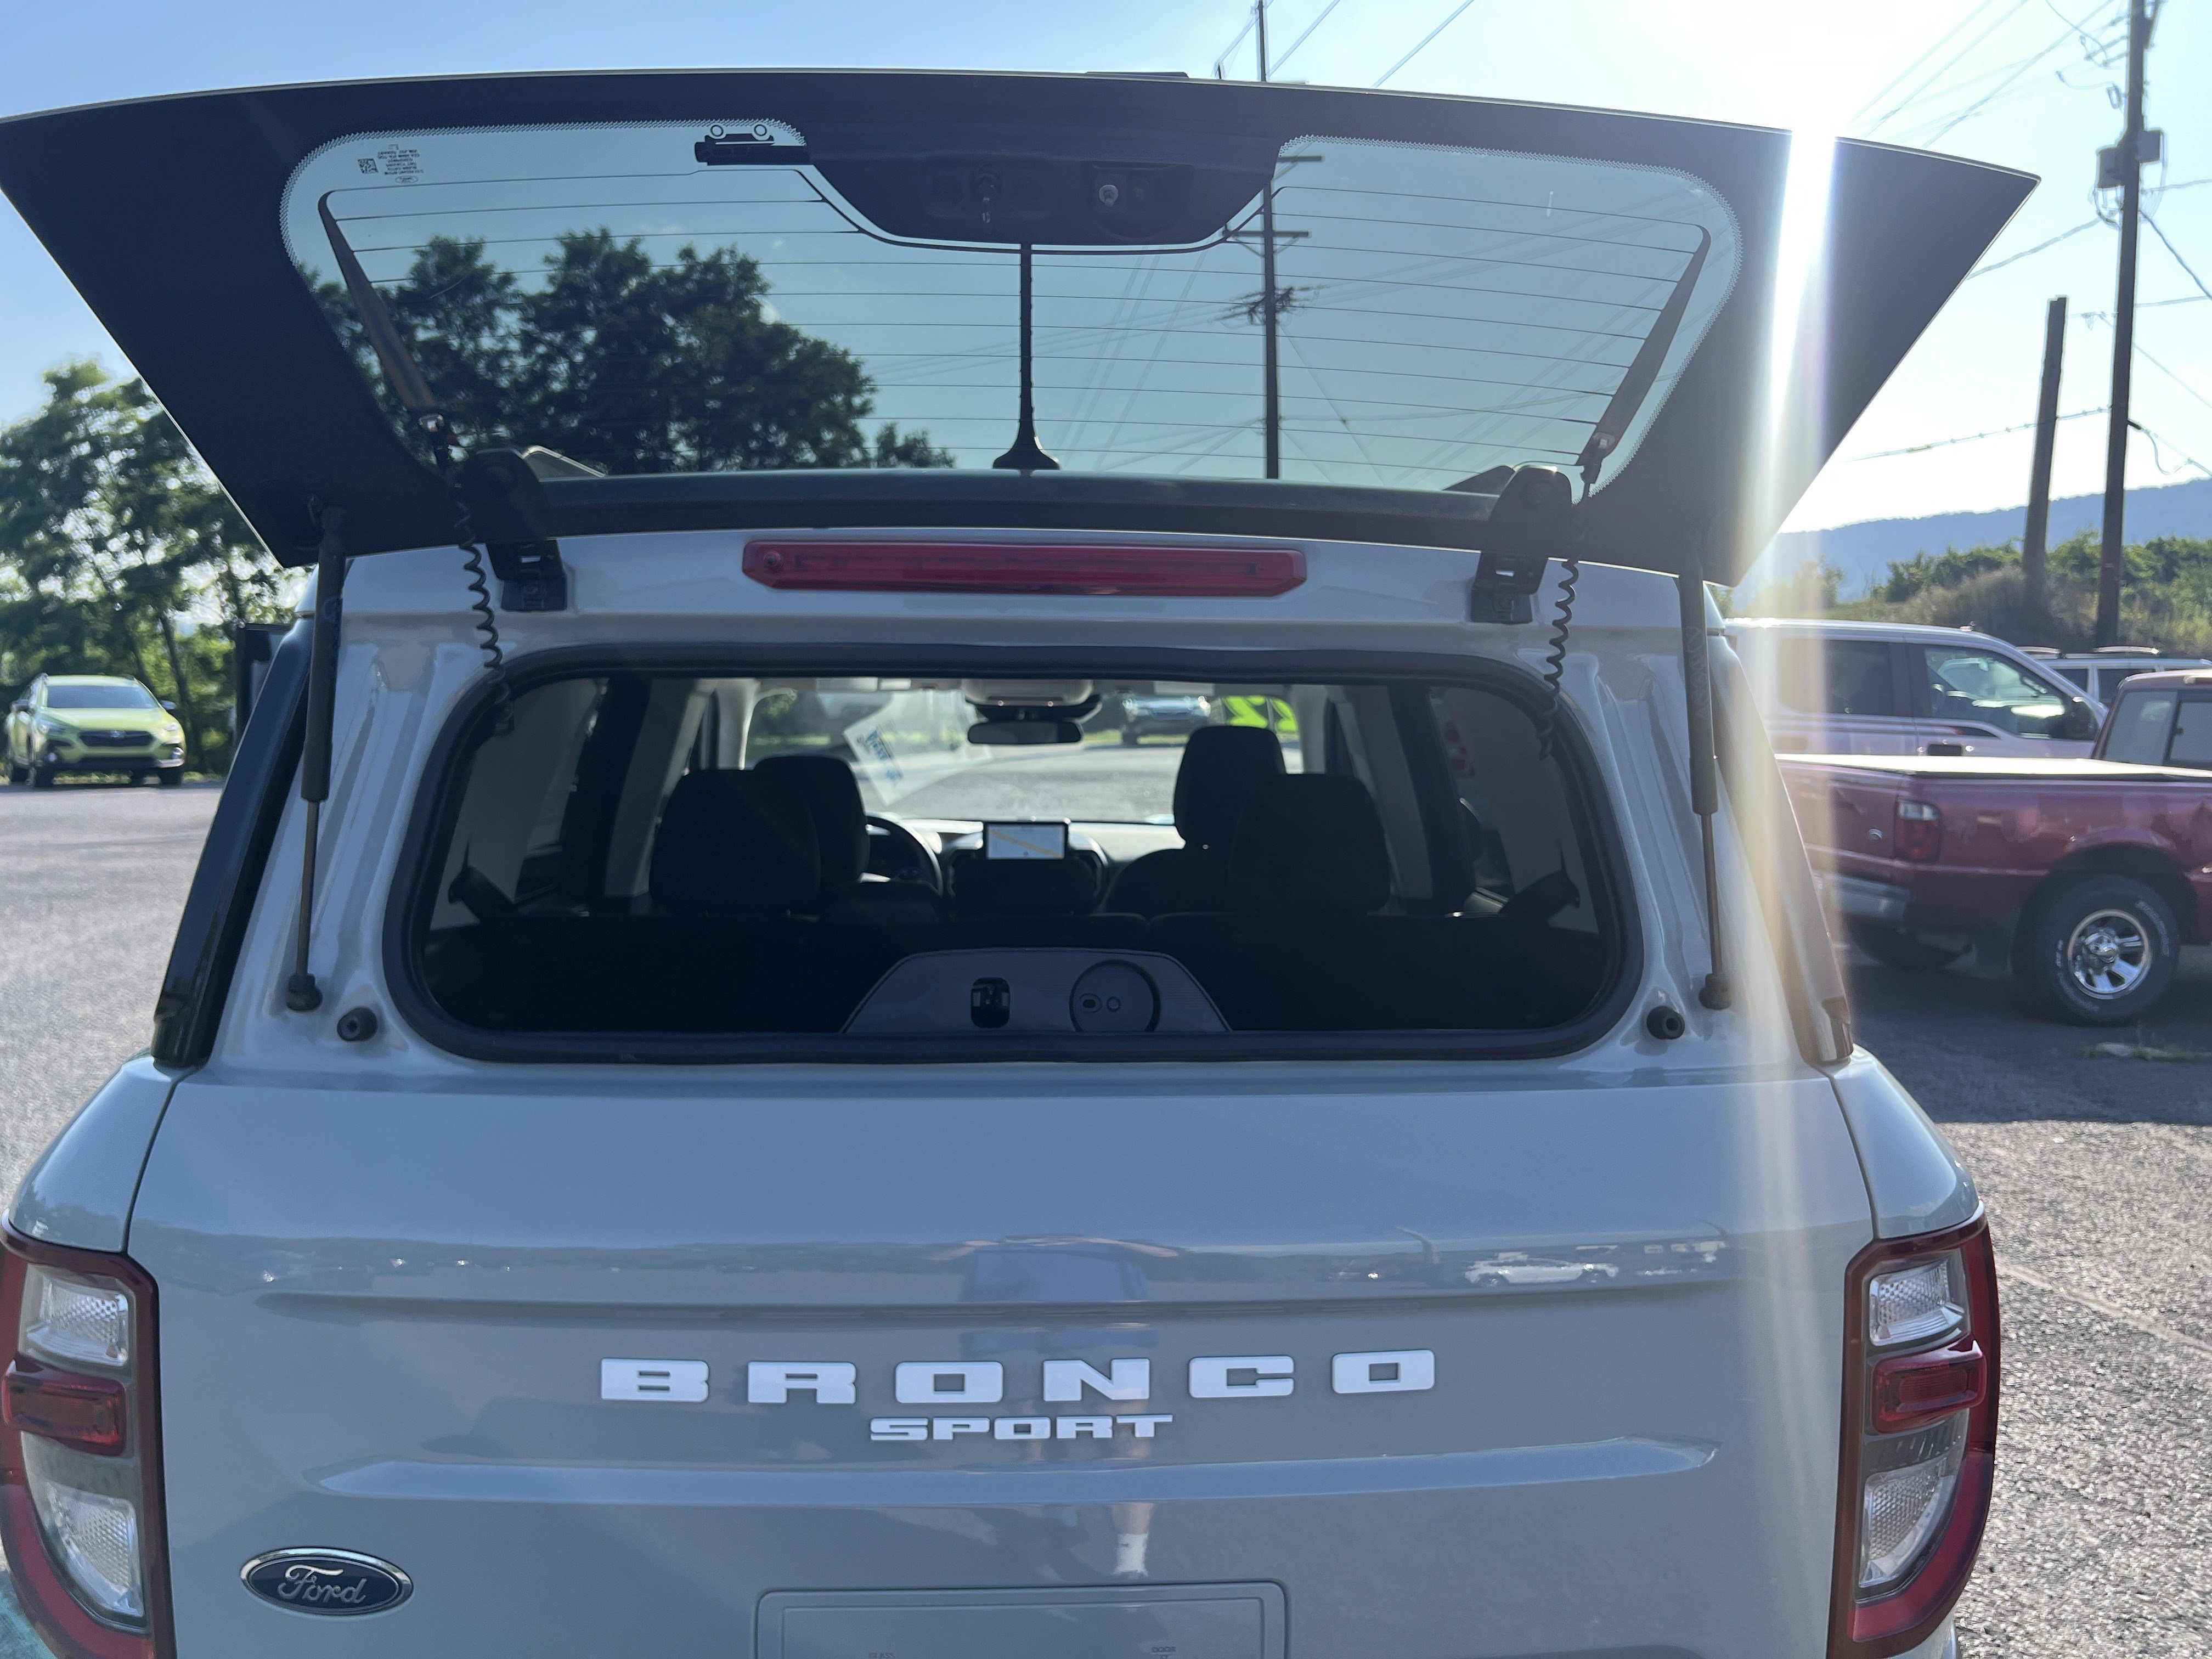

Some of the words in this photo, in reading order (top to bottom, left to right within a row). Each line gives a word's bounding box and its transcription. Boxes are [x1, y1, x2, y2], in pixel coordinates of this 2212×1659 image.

[600, 1349, 1435, 1404] BRONCO
[870, 1414, 1173, 1441] SPORT
[277, 1564, 366, 1604] Ford
